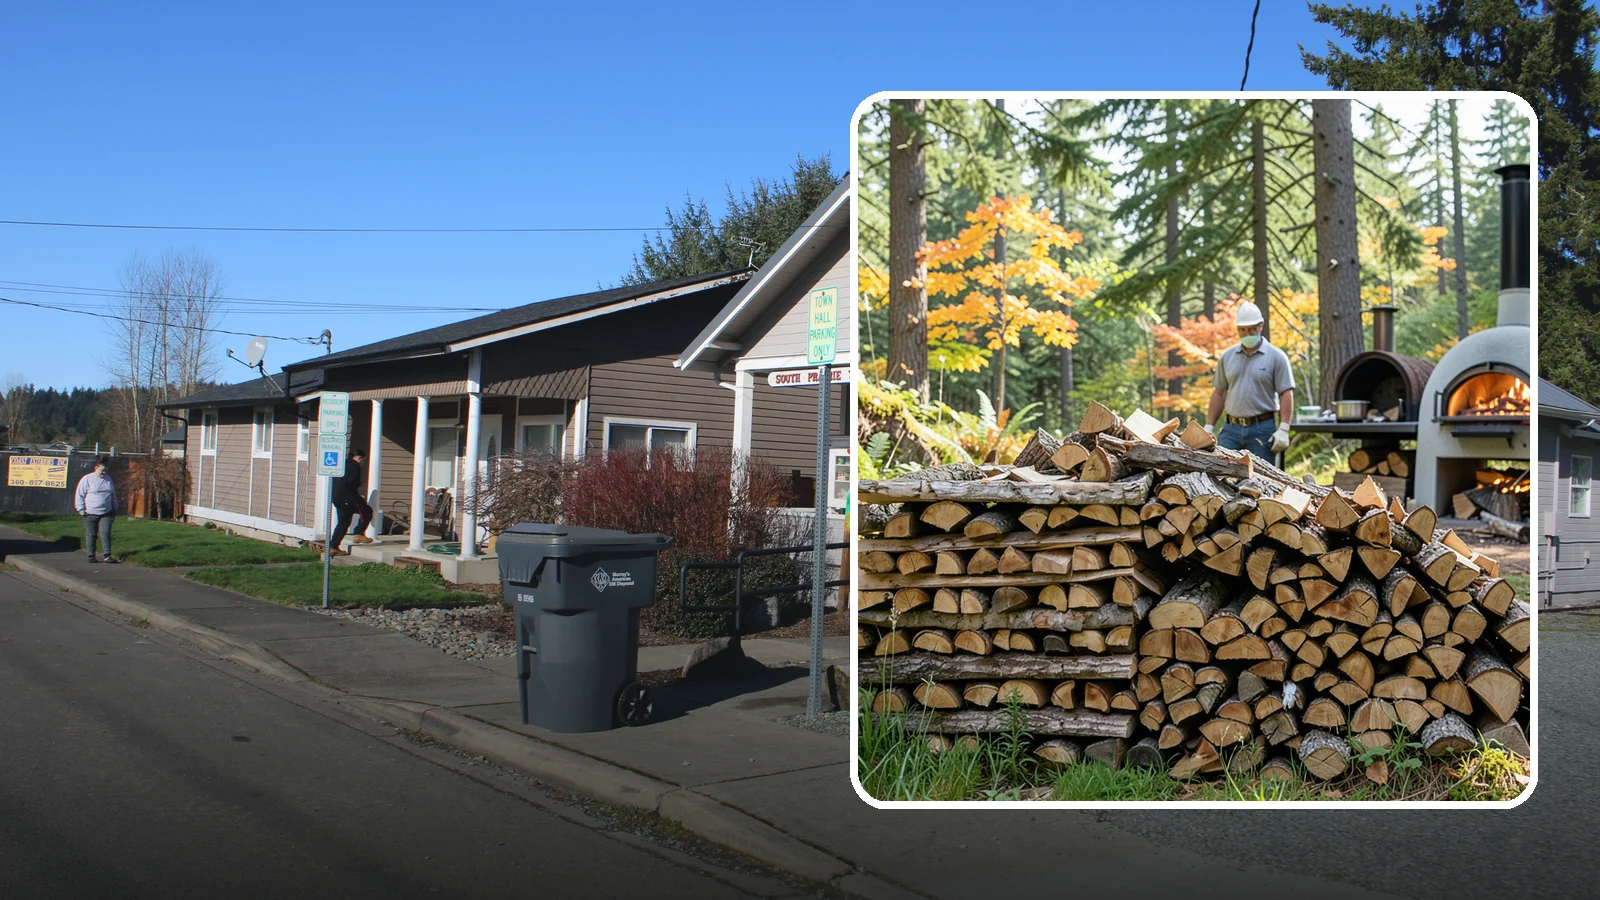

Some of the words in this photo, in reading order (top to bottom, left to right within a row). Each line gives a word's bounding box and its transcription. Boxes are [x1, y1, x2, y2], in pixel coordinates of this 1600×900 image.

[815, 295, 833, 308] TOWN
[815, 311, 831, 324] HALL
[810, 327, 836, 340] PARKING
[814, 344, 831, 357] ONLY
[776, 373, 800, 384] SOUTH
